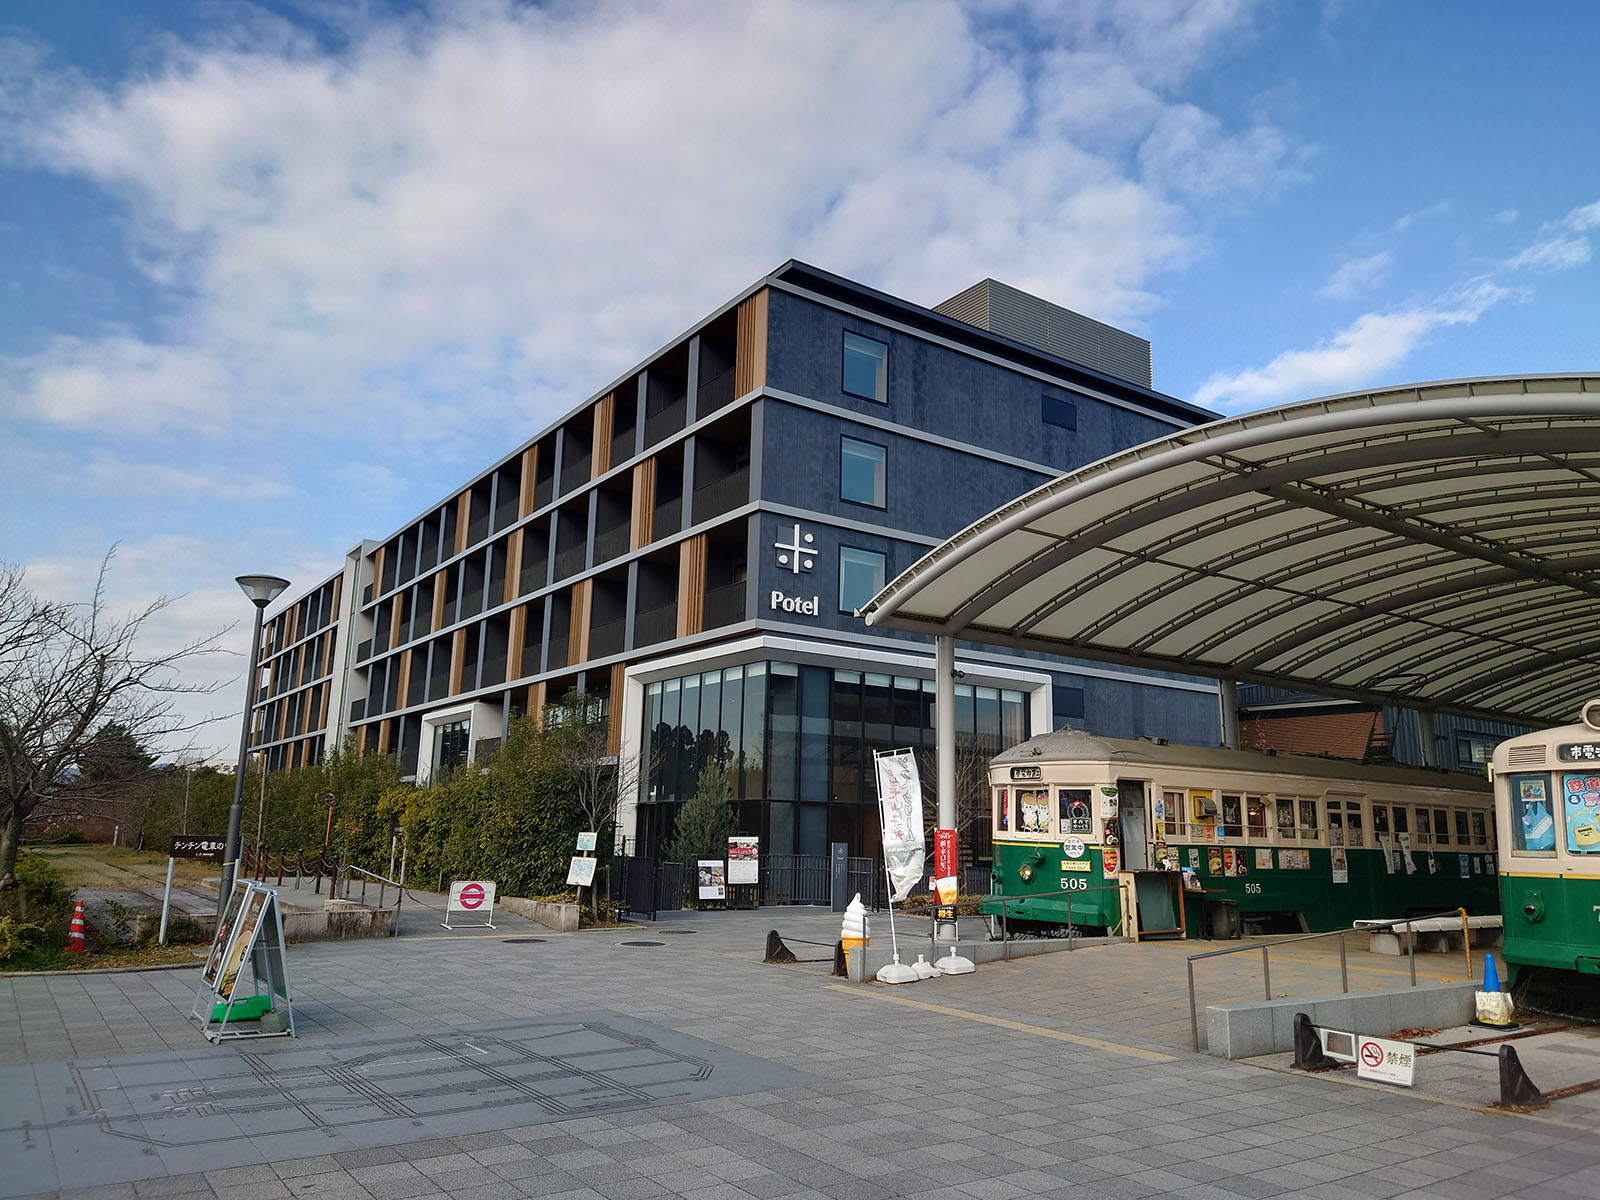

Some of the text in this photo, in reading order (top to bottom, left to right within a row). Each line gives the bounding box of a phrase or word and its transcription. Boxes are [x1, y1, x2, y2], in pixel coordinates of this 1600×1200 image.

[770, 590, 819, 616] Potel
[1060, 877, 1088, 890] 505
[1245, 883, 1261, 894] 505
[1386, 1051, 1411, 1067] 禁煙
